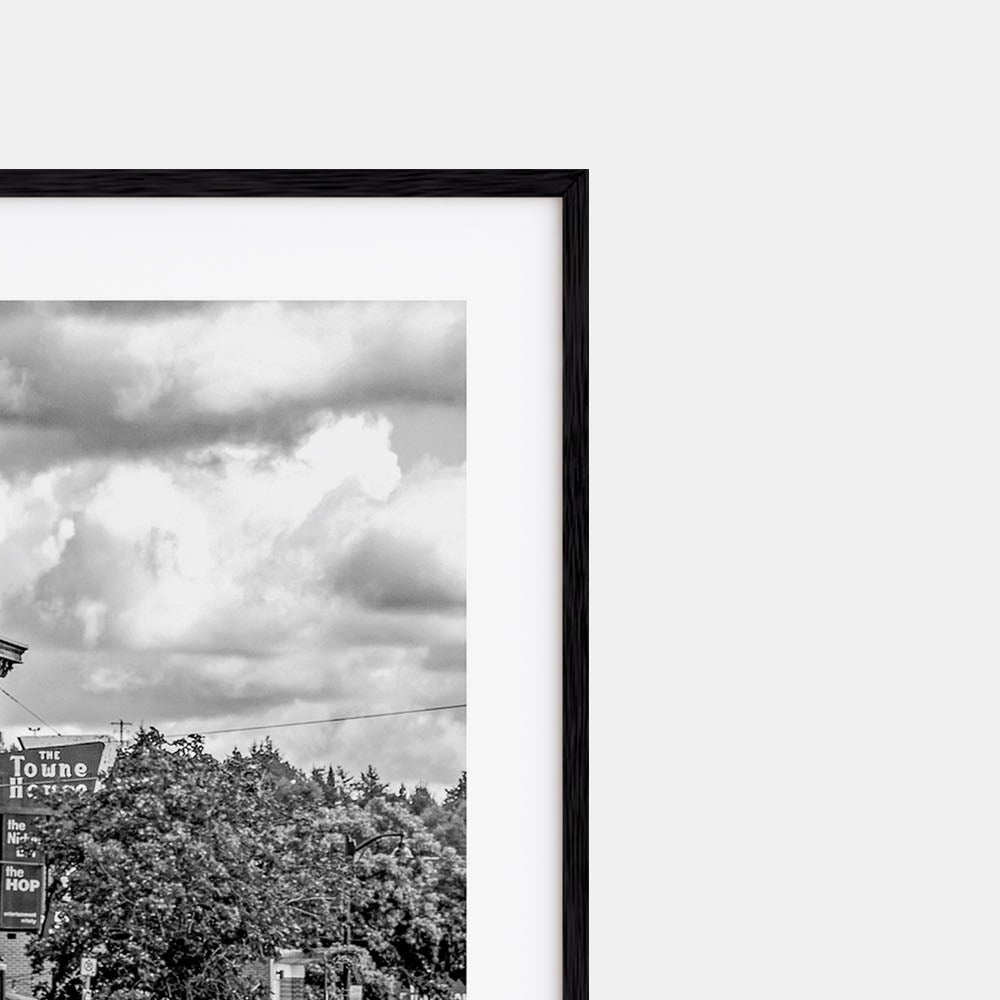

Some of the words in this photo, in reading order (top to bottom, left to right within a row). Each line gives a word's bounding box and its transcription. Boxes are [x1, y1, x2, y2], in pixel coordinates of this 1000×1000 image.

[39, 751, 60, 760] THE
[10, 755, 88, 778] Towne
[8, 819, 26, 831] the
[6, 865, 24, 878] the
[5, 879, 40, 892] HOP
